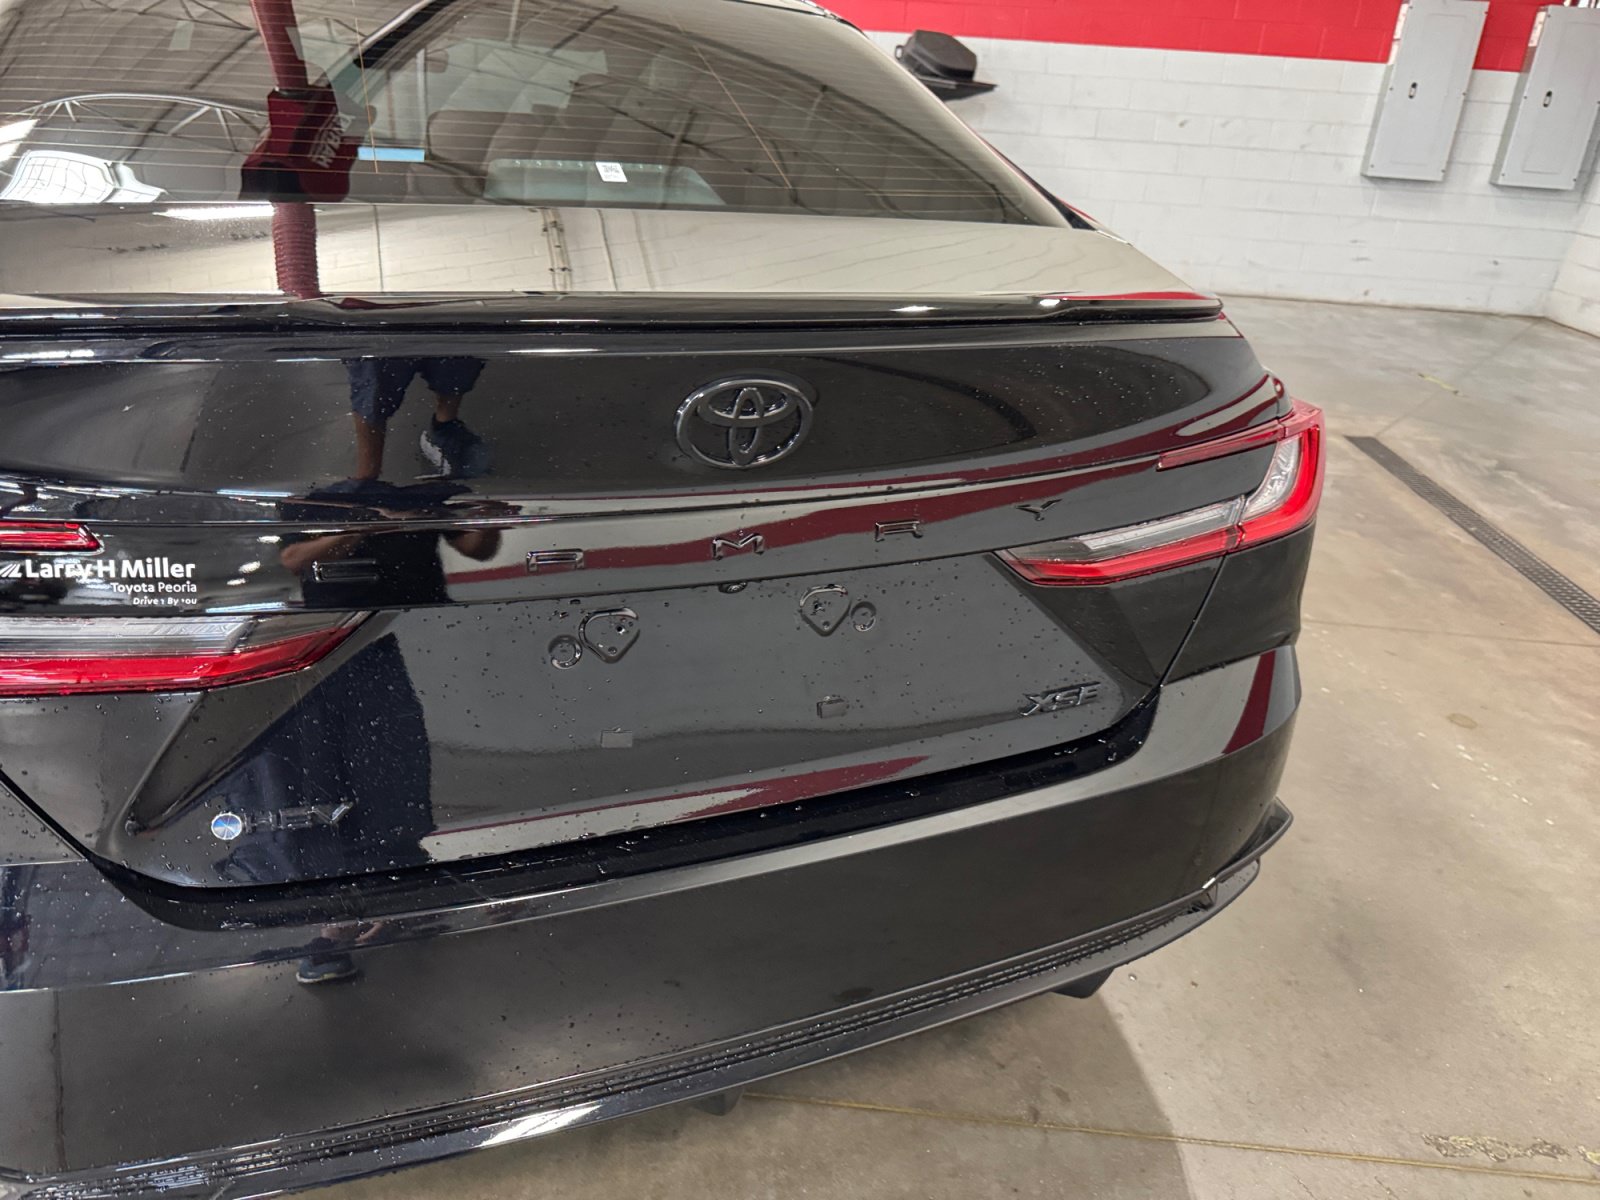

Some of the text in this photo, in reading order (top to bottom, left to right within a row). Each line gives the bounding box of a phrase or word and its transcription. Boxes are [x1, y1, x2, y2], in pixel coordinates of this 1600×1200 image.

[25, 557, 196, 582] Larry H Miller
[110, 581, 197, 595] Toyota Peoria
[167, 597, 179, 607] By
[1020, 681, 1102, 716] XSE
